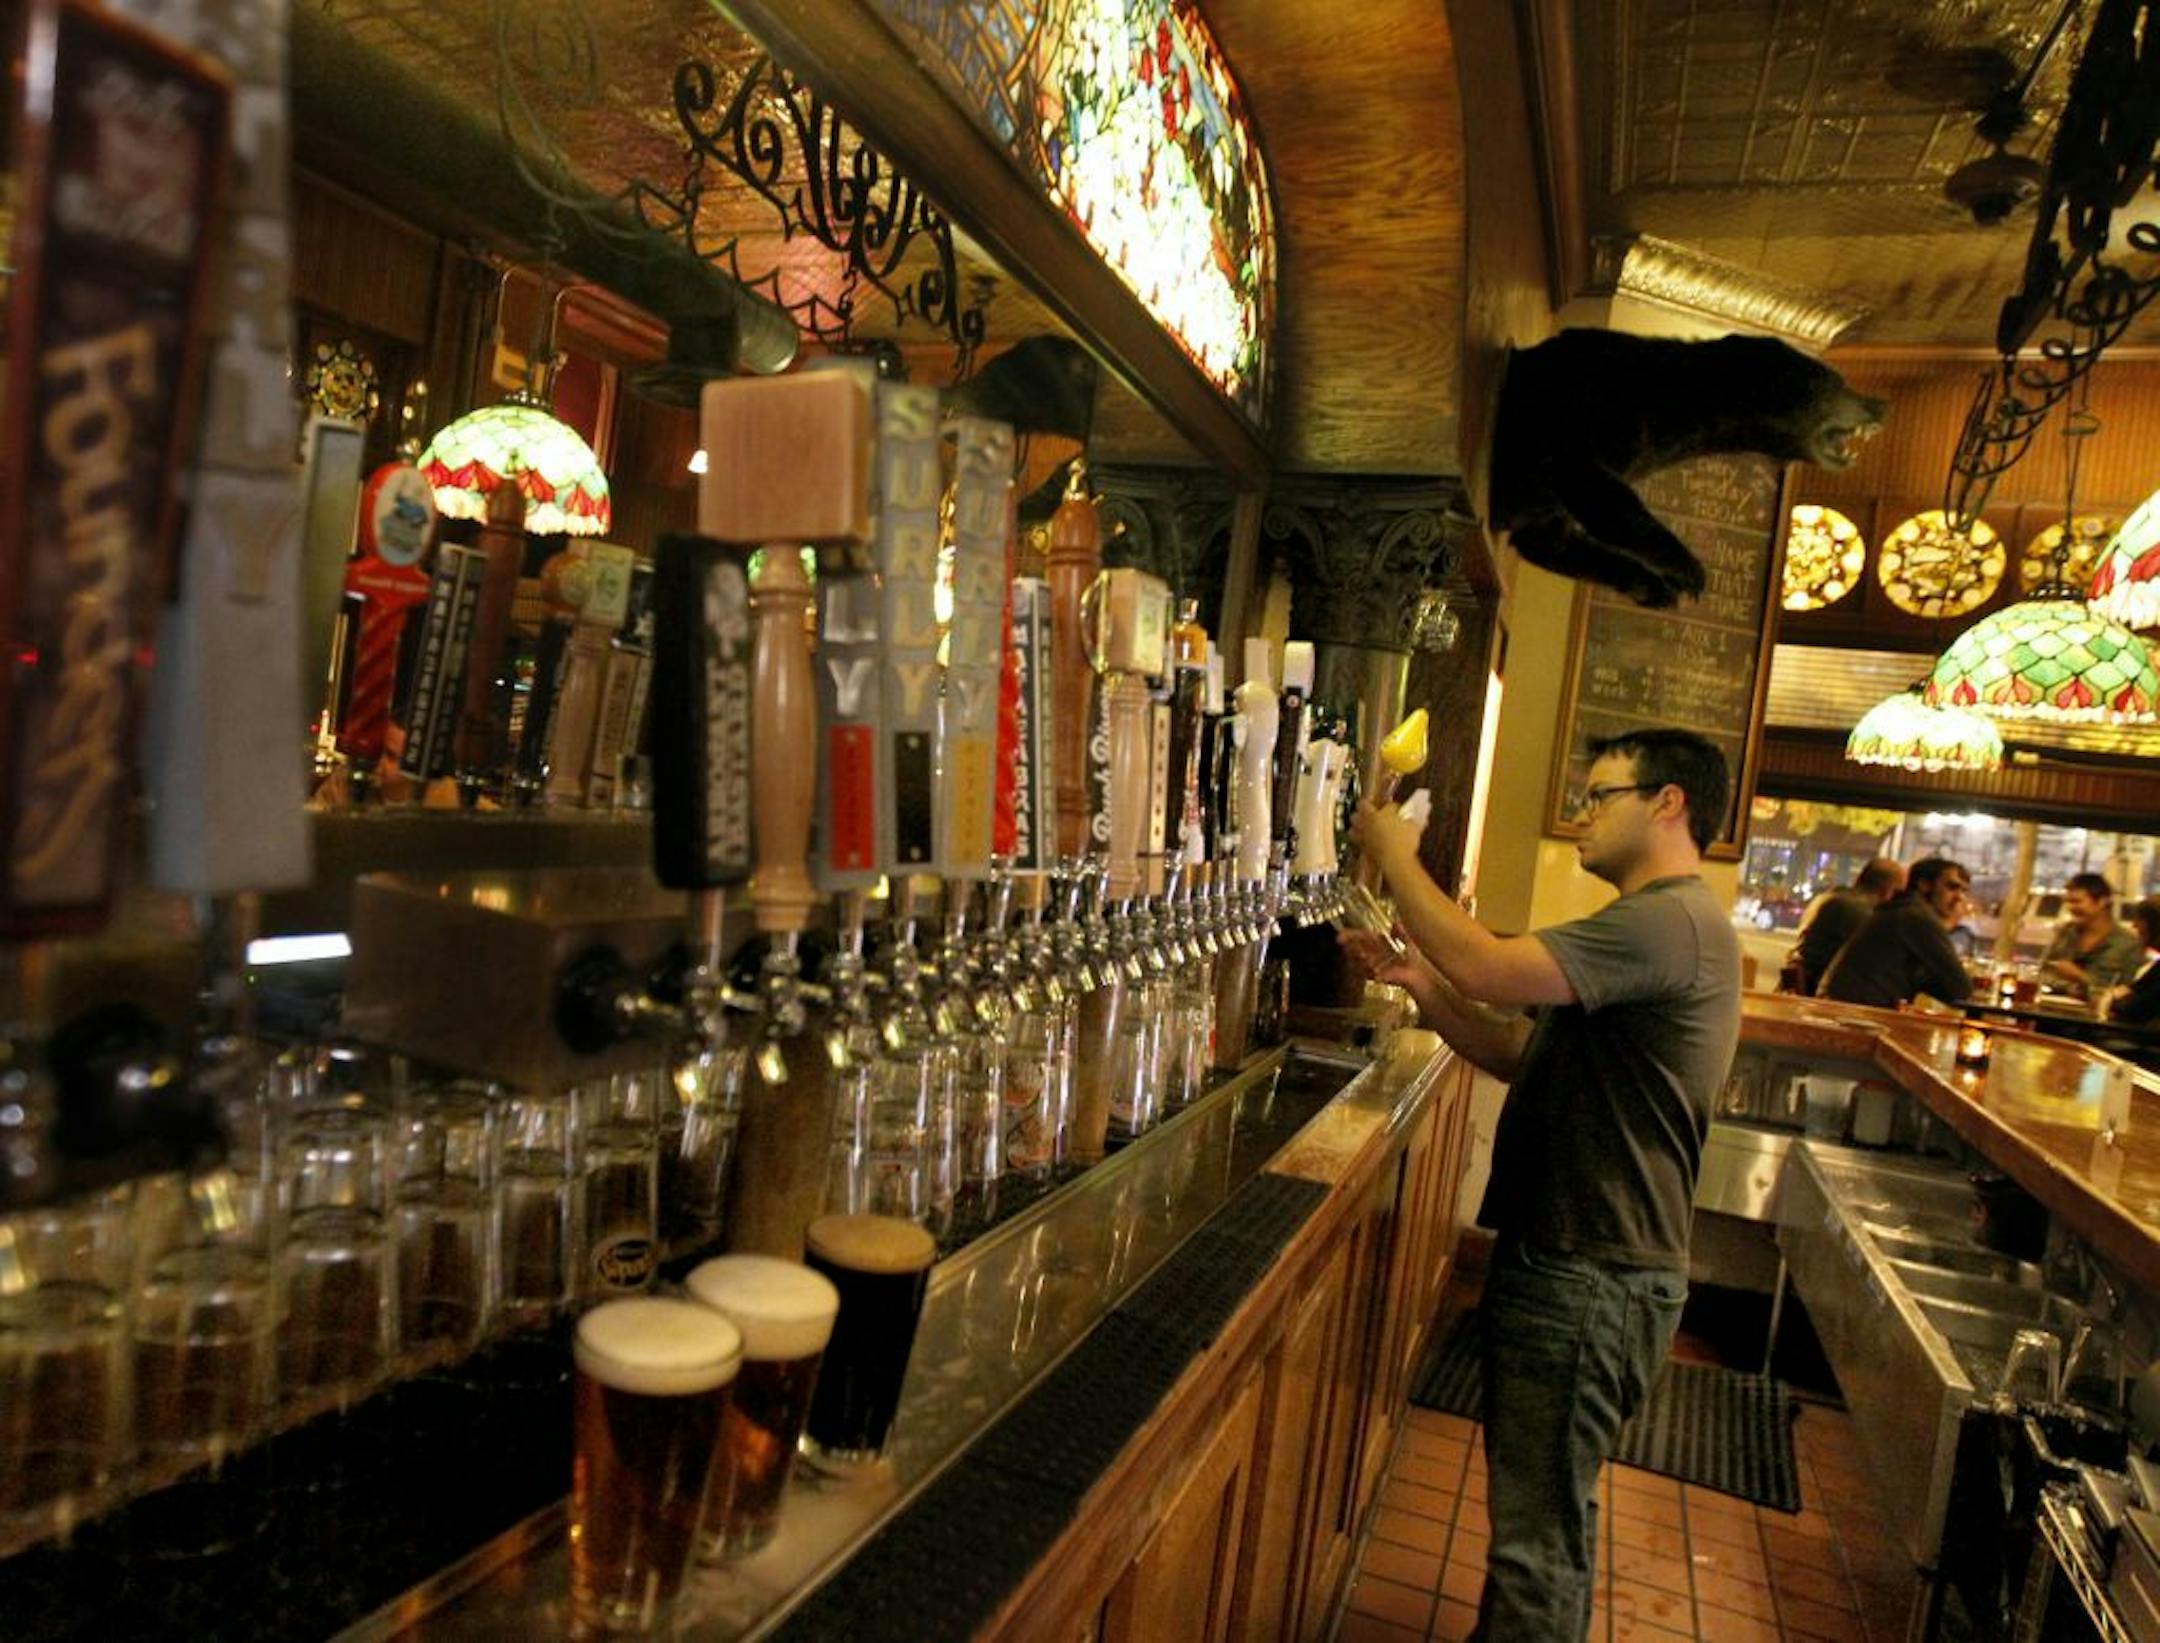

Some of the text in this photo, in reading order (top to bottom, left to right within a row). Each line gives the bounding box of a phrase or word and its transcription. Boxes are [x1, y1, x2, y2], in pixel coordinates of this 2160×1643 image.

[14, 321, 160, 880] Founders
[884, 386, 937, 716] SURLY
[955, 422, 1009, 724] SURLY
